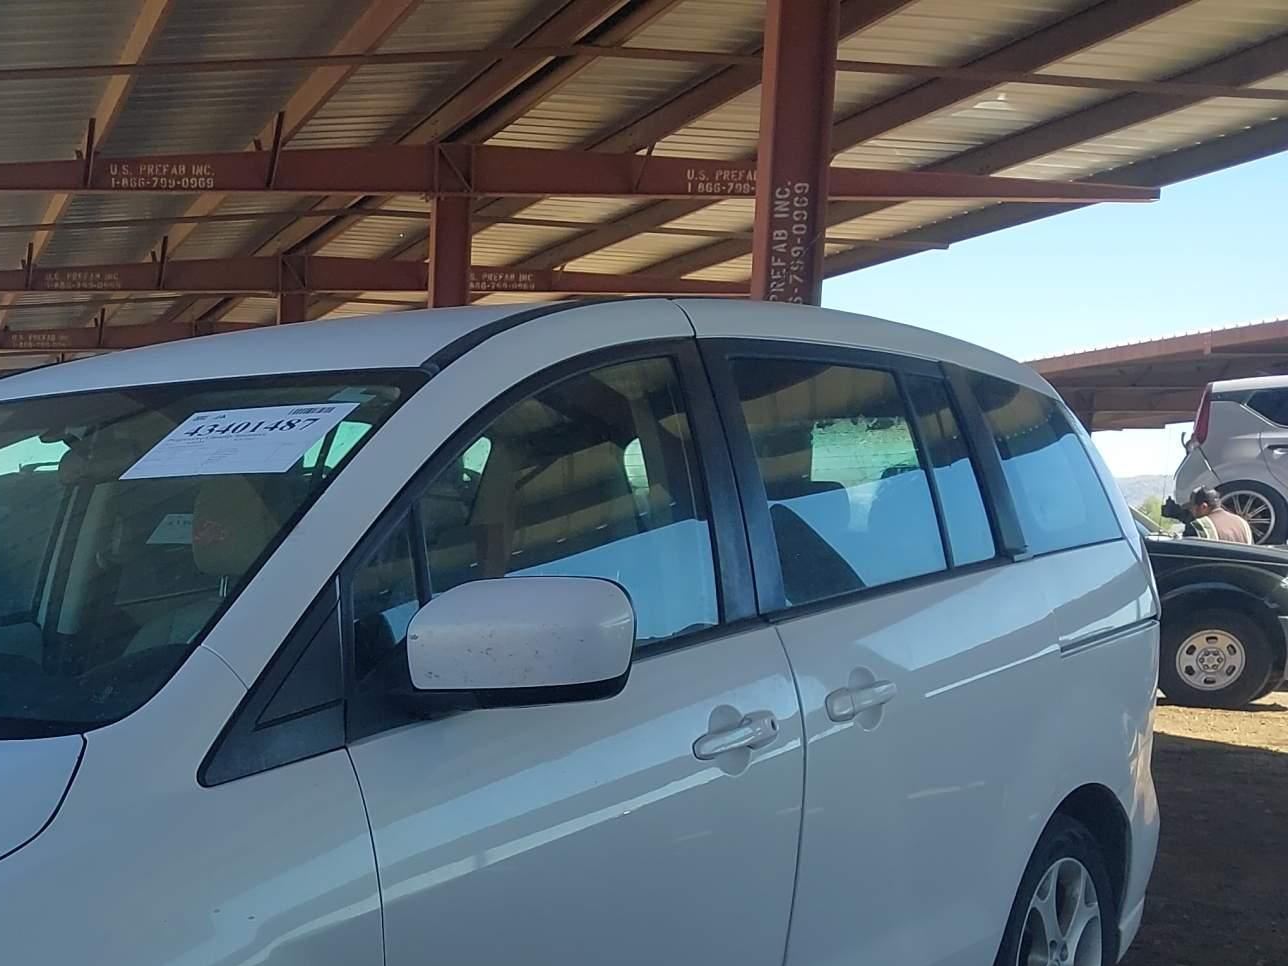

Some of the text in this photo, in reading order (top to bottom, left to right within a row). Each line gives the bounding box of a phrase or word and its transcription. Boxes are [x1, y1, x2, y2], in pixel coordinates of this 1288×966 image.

[110, 164, 215, 176] U.S. PREFAB INC.
[687, 169, 757, 181] U.S. PREFA
[111, 177, 214, 189] 1-866-799-0969
[774, 181, 790, 218] INC.
[183, 417, 321, 437] 43401487
